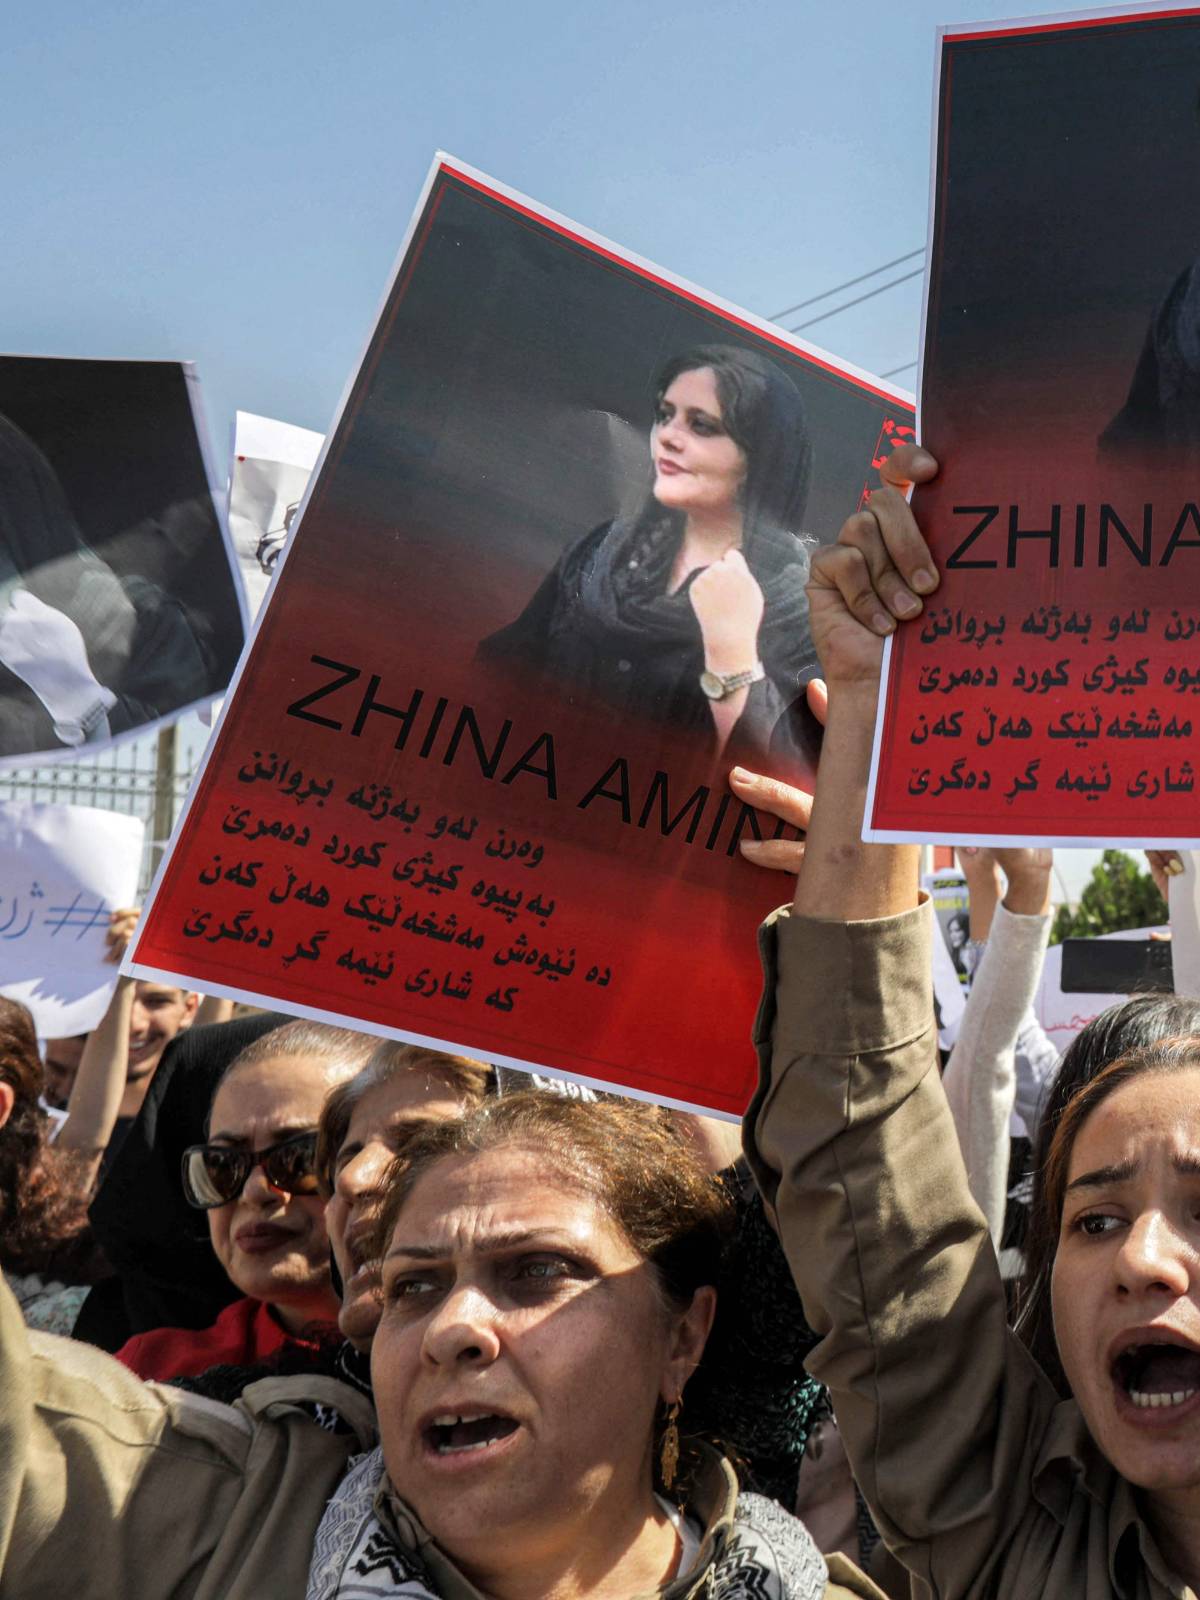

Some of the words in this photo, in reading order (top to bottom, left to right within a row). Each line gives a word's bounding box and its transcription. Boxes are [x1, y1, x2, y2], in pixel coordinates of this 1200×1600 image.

[920, 608, 1006, 649] بڕوانن
[1021, 604, 1092, 644] بەژنە
[1103, 608, 1150, 641] لەو
[918, 664, 998, 694] دەمرێ
[1012, 658, 1071, 694] کورد
[1082, 655, 1149, 695] کیژی
[286, 655, 557, 800] ZHINA
[238, 751, 334, 807] بڕوانن
[908, 757, 991, 797] دەگرێ
[1003, 759, 1041, 805] گڕ
[1055, 762, 1112, 801] ئێمە
[1126, 761, 1195, 799] شاری
[222, 804, 311, 847] دەمرێ
[346, 783, 421, 834] بەژنە
[426, 815, 479, 841] لەو
[322, 835, 387, 869] کورد
[485, 829, 545, 868] وەرن
[393, 851, 464, 895] کیژی
[182, 909, 274, 949] دەگرێ
[282, 930, 331, 968] گڕ
[336, 947, 395, 988] ئێمە
[493, 933, 576, 982] ئێوەش
[585, 965, 613, 987] دە
[404, 967, 473, 1000] شاری
[485, 987, 520, 1012] کە
